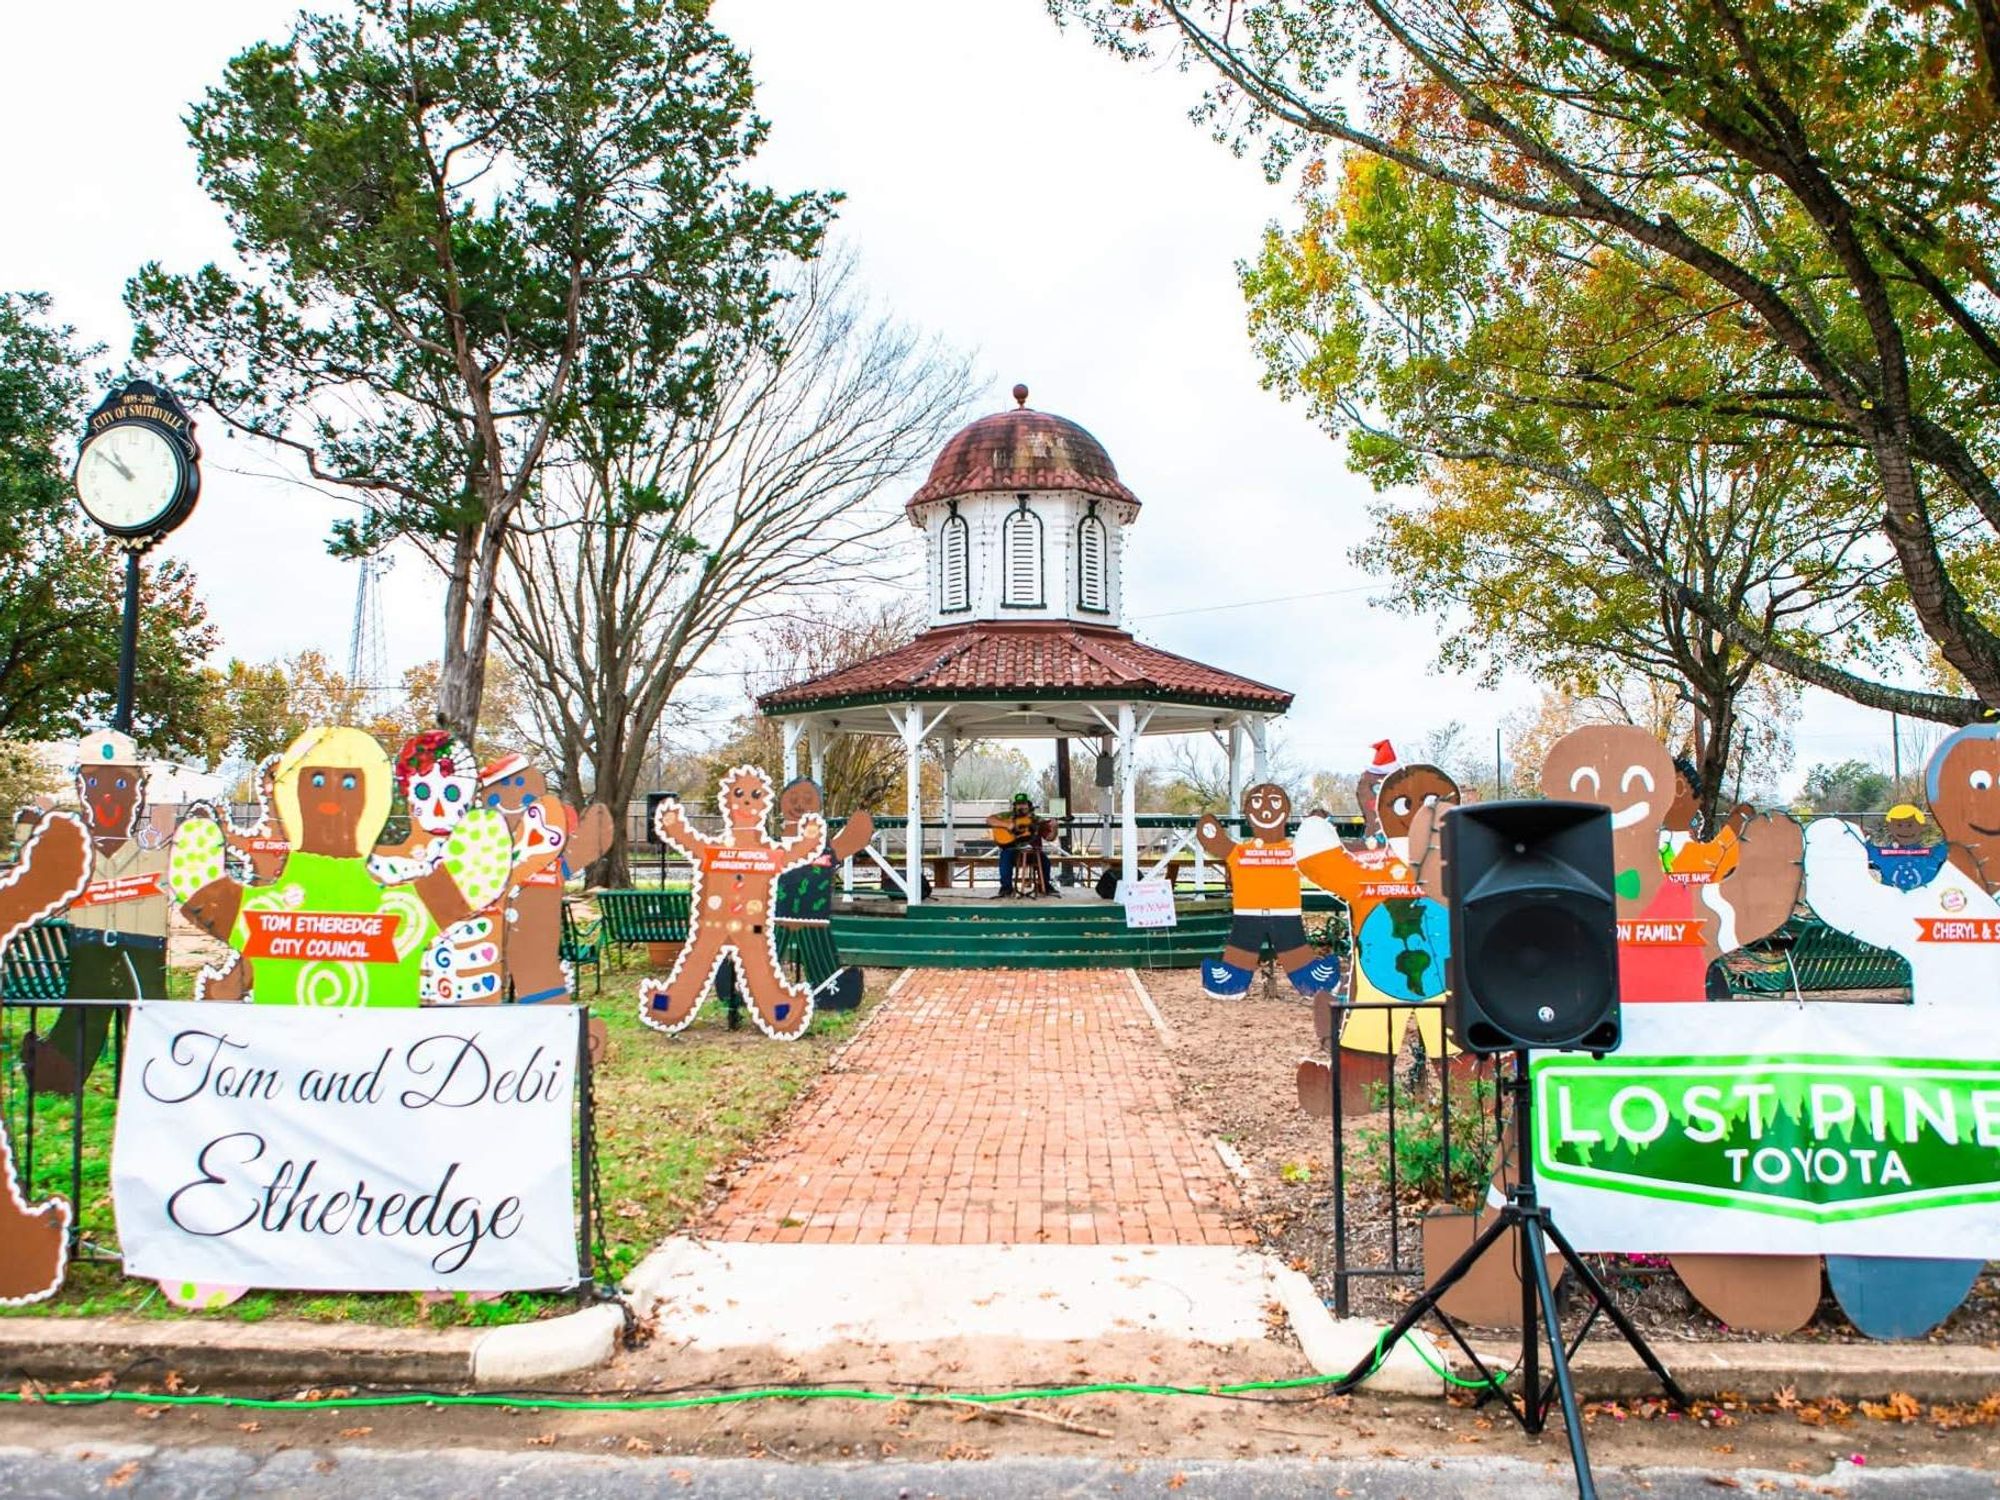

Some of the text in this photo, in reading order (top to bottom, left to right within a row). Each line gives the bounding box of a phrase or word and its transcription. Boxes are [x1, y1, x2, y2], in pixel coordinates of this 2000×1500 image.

[92, 404, 184, 430] CITY OF SMITHVILLE
[1377, 884, 1410, 896] FEDERAL
[259, 914, 383, 935] TOM ETHEREDGE
[1636, 924, 1687, 942] FAMILY
[1932, 921, 1979, 940] CHERYL
[1981, 921, 1992, 940] &
[270, 937, 370, 958] CITY COUNCIL
[142, 1029, 563, 1109] Tom and Debi
[1558, 1083, 2000, 1147] LOST PINE
[1725, 1148, 1912, 1186] TOYOTA
[167, 1132, 524, 1274] Etheredge
